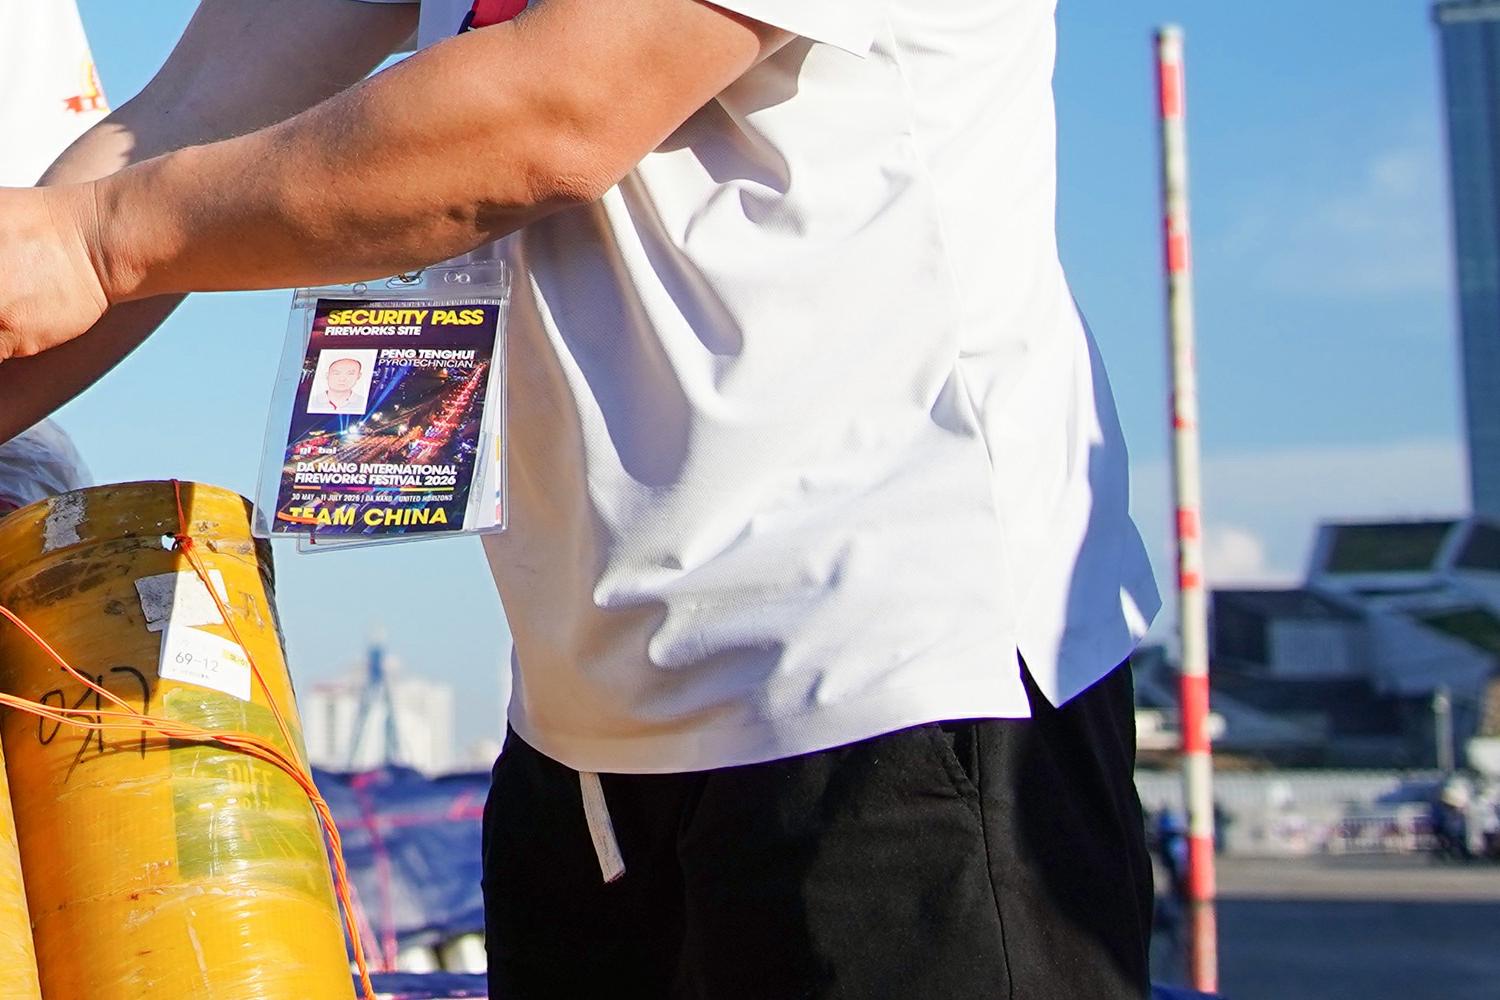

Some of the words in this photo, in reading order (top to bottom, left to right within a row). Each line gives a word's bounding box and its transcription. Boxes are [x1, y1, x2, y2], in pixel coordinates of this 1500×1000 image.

[328, 309, 429, 326] SECURITY
[431, 309, 485, 326] PASS
[324, 326, 396, 336] FIREWORKS
[397, 326, 422, 336] SITE
[380, 349, 417, 360] PENG
[418, 350, 476, 360] TENGHUI
[378, 359, 474, 369] PYROTECHNICIAN
[296, 461, 314, 474] DA
[318, 462, 358, 475] NANG
[359, 463, 458, 476] INTERNATIONAL
[294, 472, 367, 485] FIREWORKS
[368, 474, 423, 486] FESTIVAL
[424, 475, 457, 486] 2026
[291, 493, 300, 501] 30
[301, 493, 315, 501] MAY
[327, 494, 342, 502] JULY
[343, 494, 360, 502] 2026
[289, 506, 357, 526] TEAM
[363, 507, 448, 526] CHINA
[175, 651, 220, 673] 69-12
